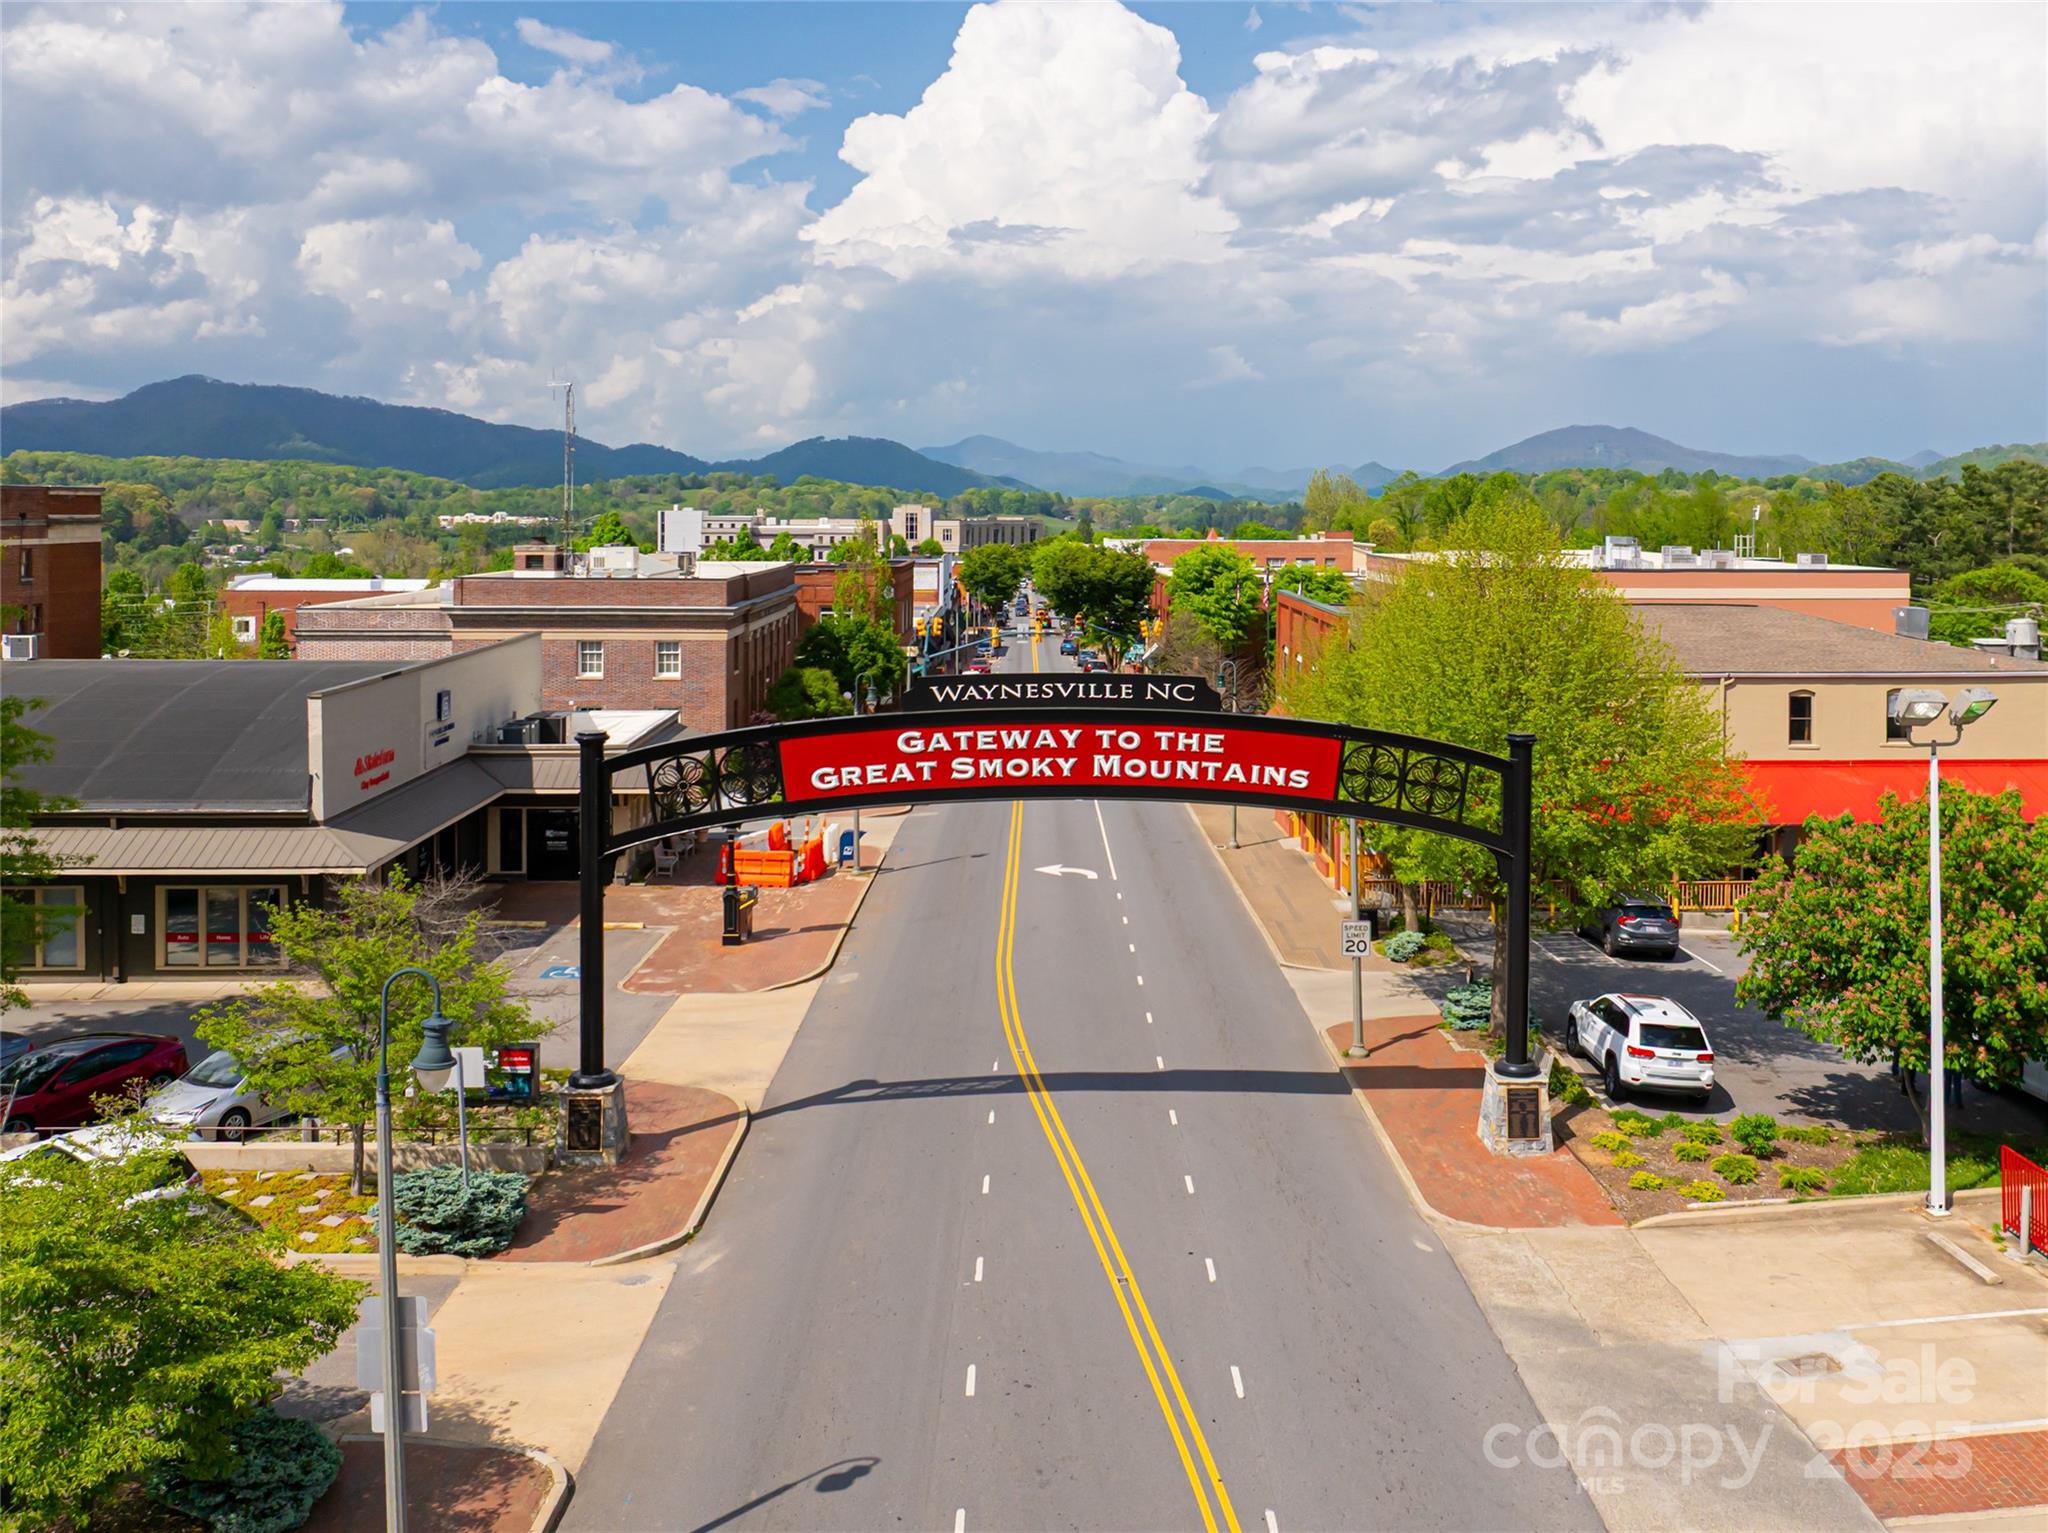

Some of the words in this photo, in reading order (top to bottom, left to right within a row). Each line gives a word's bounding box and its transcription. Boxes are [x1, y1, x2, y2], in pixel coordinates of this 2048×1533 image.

[929, 683, 1133, 702] WAYNESVILLE
[1145, 683, 1196, 701] NC
[896, 729, 1083, 753] GATEWAY
[1095, 729, 1141, 751] TO
[1154, 731, 1225, 753] THE
[811, 761, 938, 790] GREAT
[950, 757, 1078, 780] SMOKY
[1093, 755, 1310, 789] MOUNTAINS
[1345, 940, 1367, 953] 20
